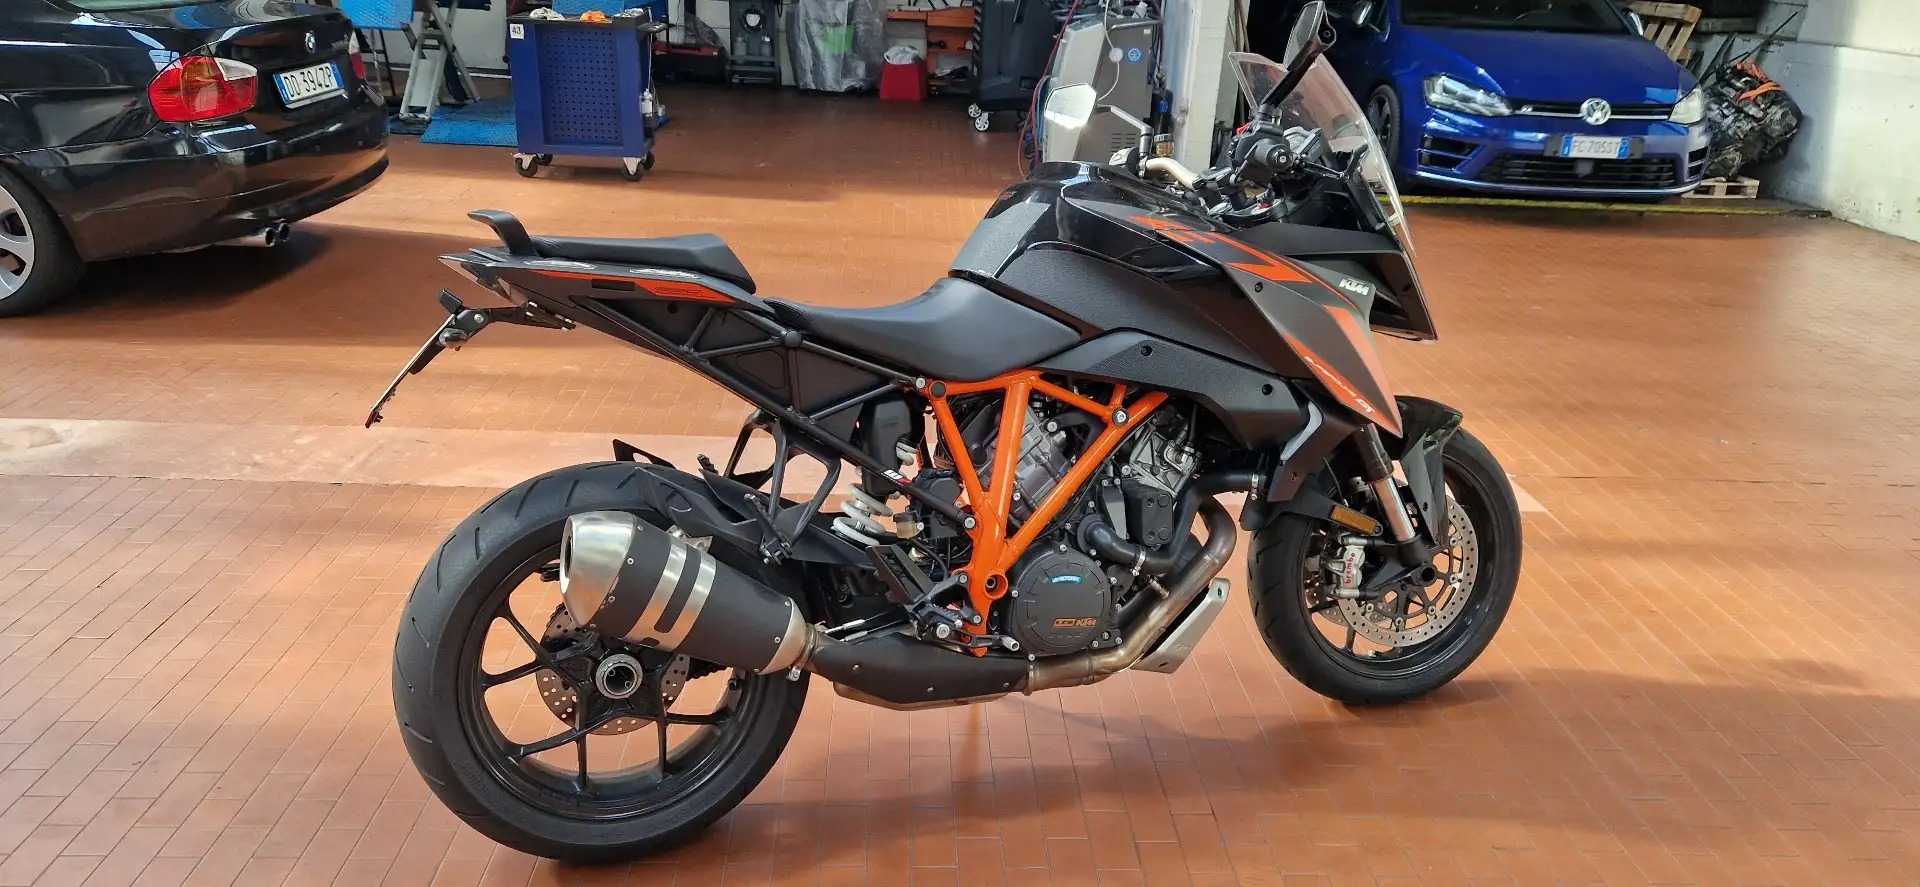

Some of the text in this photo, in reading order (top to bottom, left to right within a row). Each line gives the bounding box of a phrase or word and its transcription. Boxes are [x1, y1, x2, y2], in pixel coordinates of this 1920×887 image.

[512, 26, 521, 34] 43
[1339, 277, 1369, 295] KTM
[1344, 552, 1356, 584] brembo
